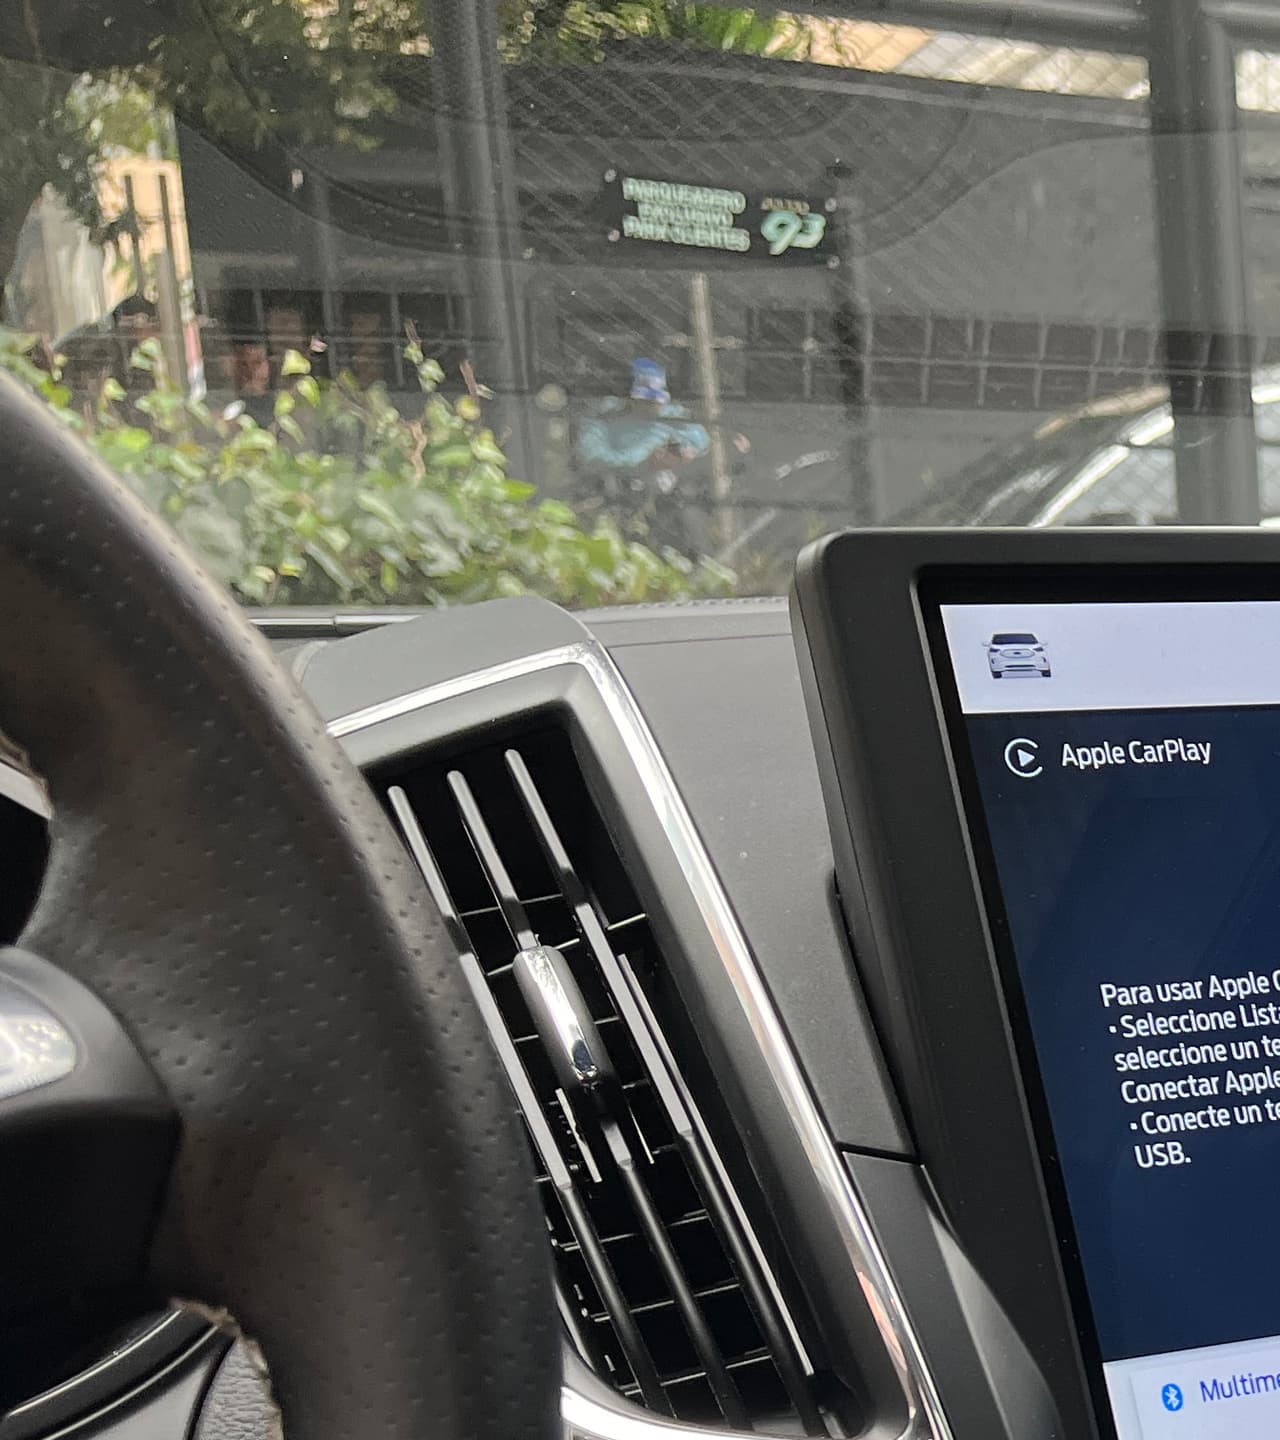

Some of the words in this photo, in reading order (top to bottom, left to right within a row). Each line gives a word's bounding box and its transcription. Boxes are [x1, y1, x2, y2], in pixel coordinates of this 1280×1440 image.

[760, 209, 827, 256] 93
[1061, 741, 1126, 770] Apple
[1128, 738, 1211, 765] CarPlay
[1100, 983, 1155, 1008] Para
[1155, 980, 1203, 1002] usar
[1208, 971, 1271, 1001] Apple
[1120, 1009, 1237, 1038] Seleccione
[1114, 1042, 1228, 1072] seleccione
[1230, 1040, 1260, 1060] un
[1121, 1074, 1220, 1104] Conectar
[1140, 1105, 1231, 1135] Conecte
[1233, 1104, 1263, 1125] un
[1134, 1141, 1192, 1169] USB.
